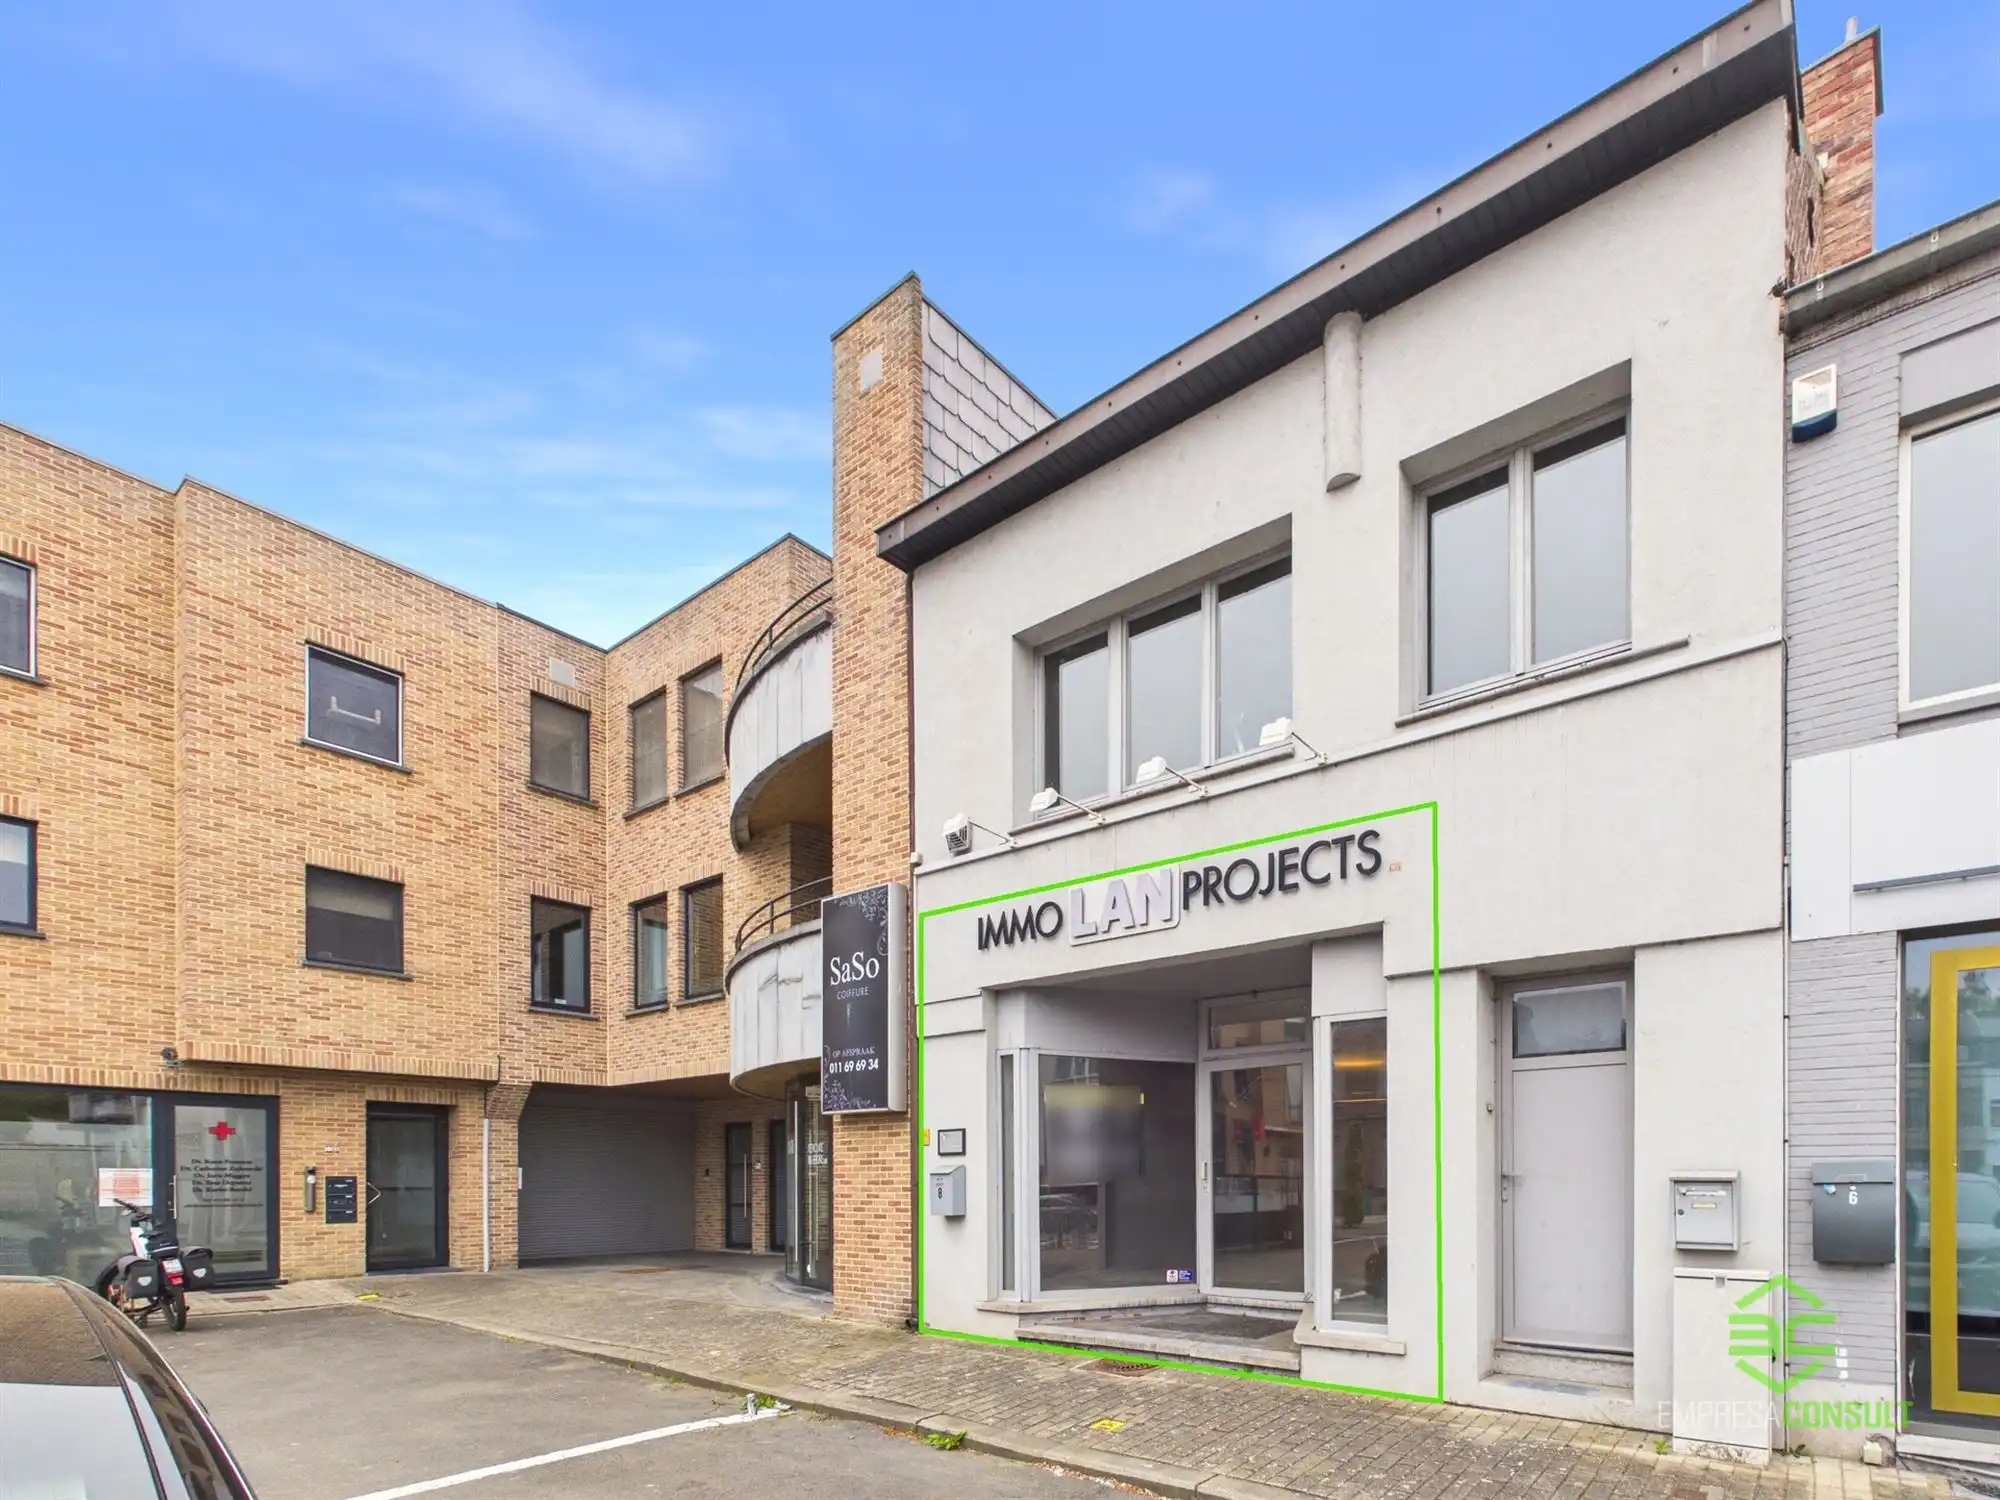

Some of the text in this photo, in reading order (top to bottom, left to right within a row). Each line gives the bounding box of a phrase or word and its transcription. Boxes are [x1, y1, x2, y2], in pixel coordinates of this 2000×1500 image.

[978, 829, 1382, 950] IMMO LAN PROJECTS
[830, 951, 880, 986] SaSo
[836, 986, 869, 1000] COIFFURE
[829, 1058, 879, 1074] 011 69 69 34
[937, 1187, 943, 1199] 8
[1848, 1191, 1858, 1205] 6
